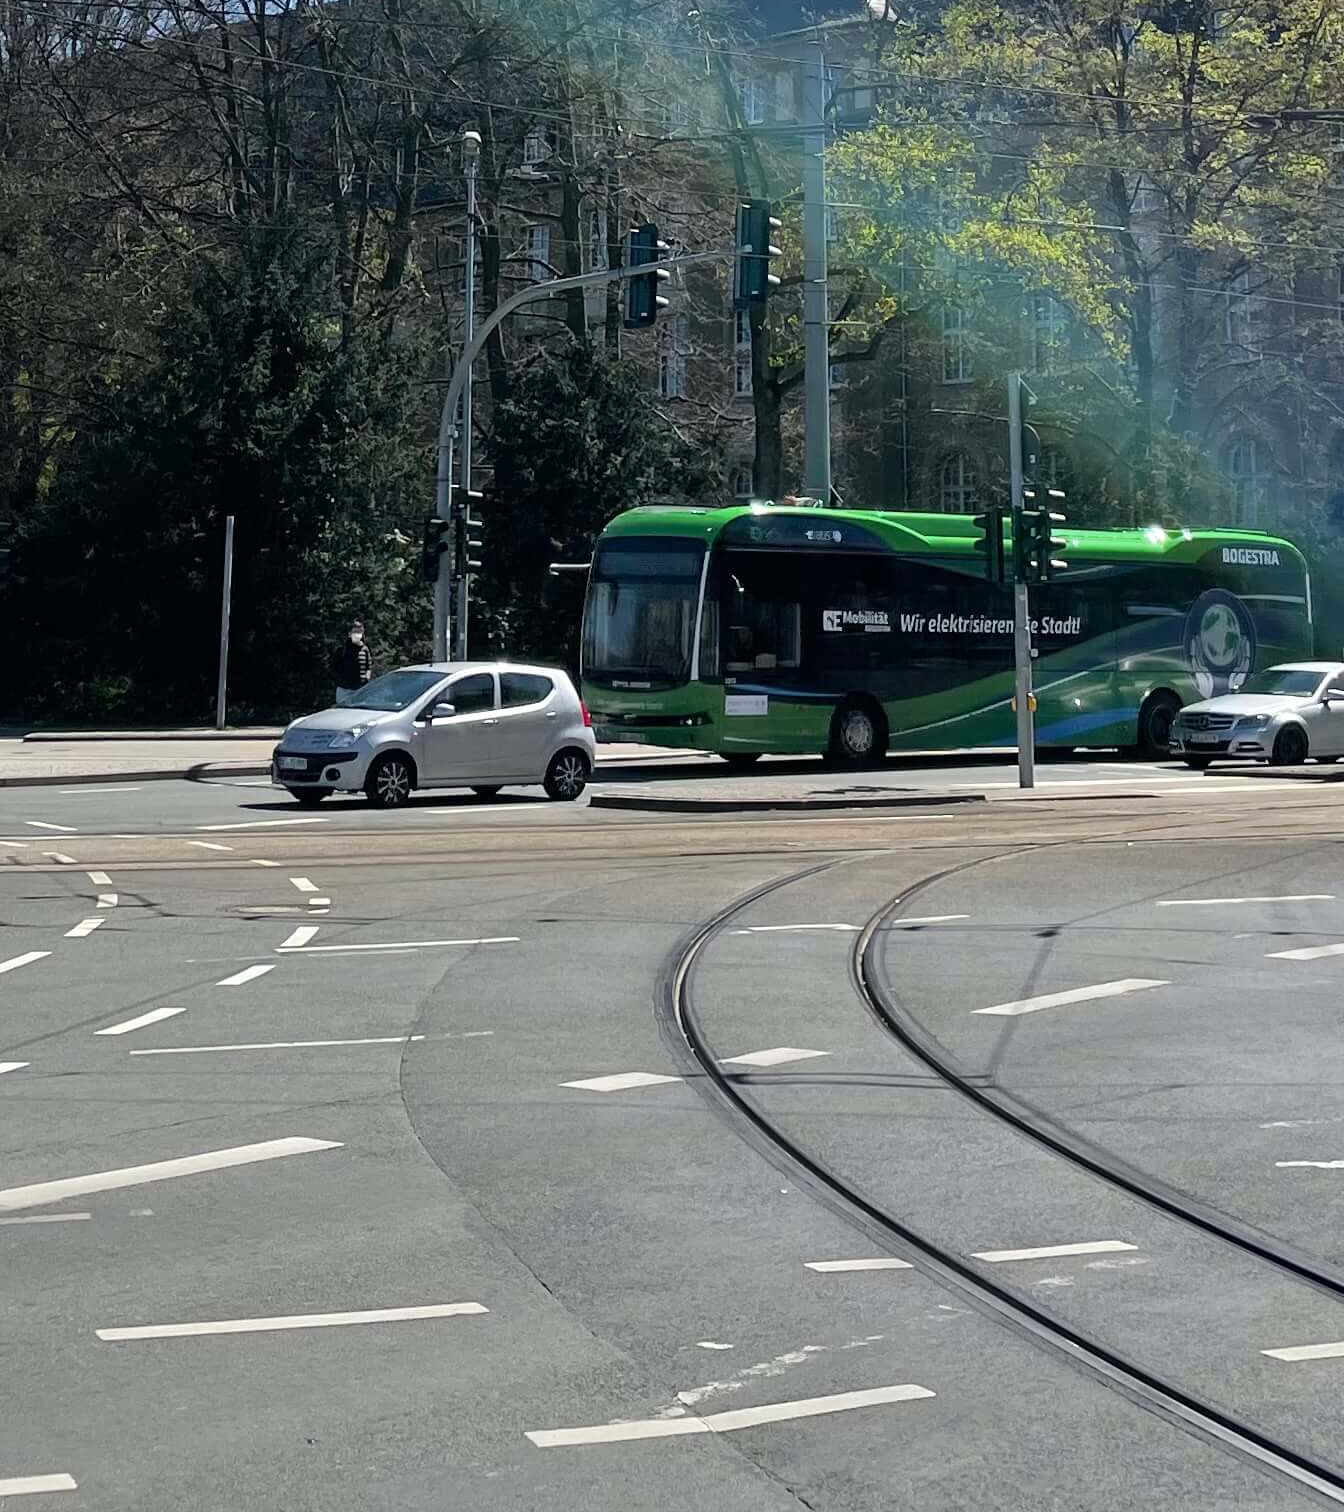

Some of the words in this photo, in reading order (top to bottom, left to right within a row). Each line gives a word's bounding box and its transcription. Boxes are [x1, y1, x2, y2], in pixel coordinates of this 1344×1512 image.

[1222, 548, 1280, 566] BOGESTRA
[843, 610, 889, 625] Mobilität
[900, 613, 926, 633] Wir
[928, 613, 1014, 634] elektrisieren
[1041, 615, 1081, 634] Stadt!
